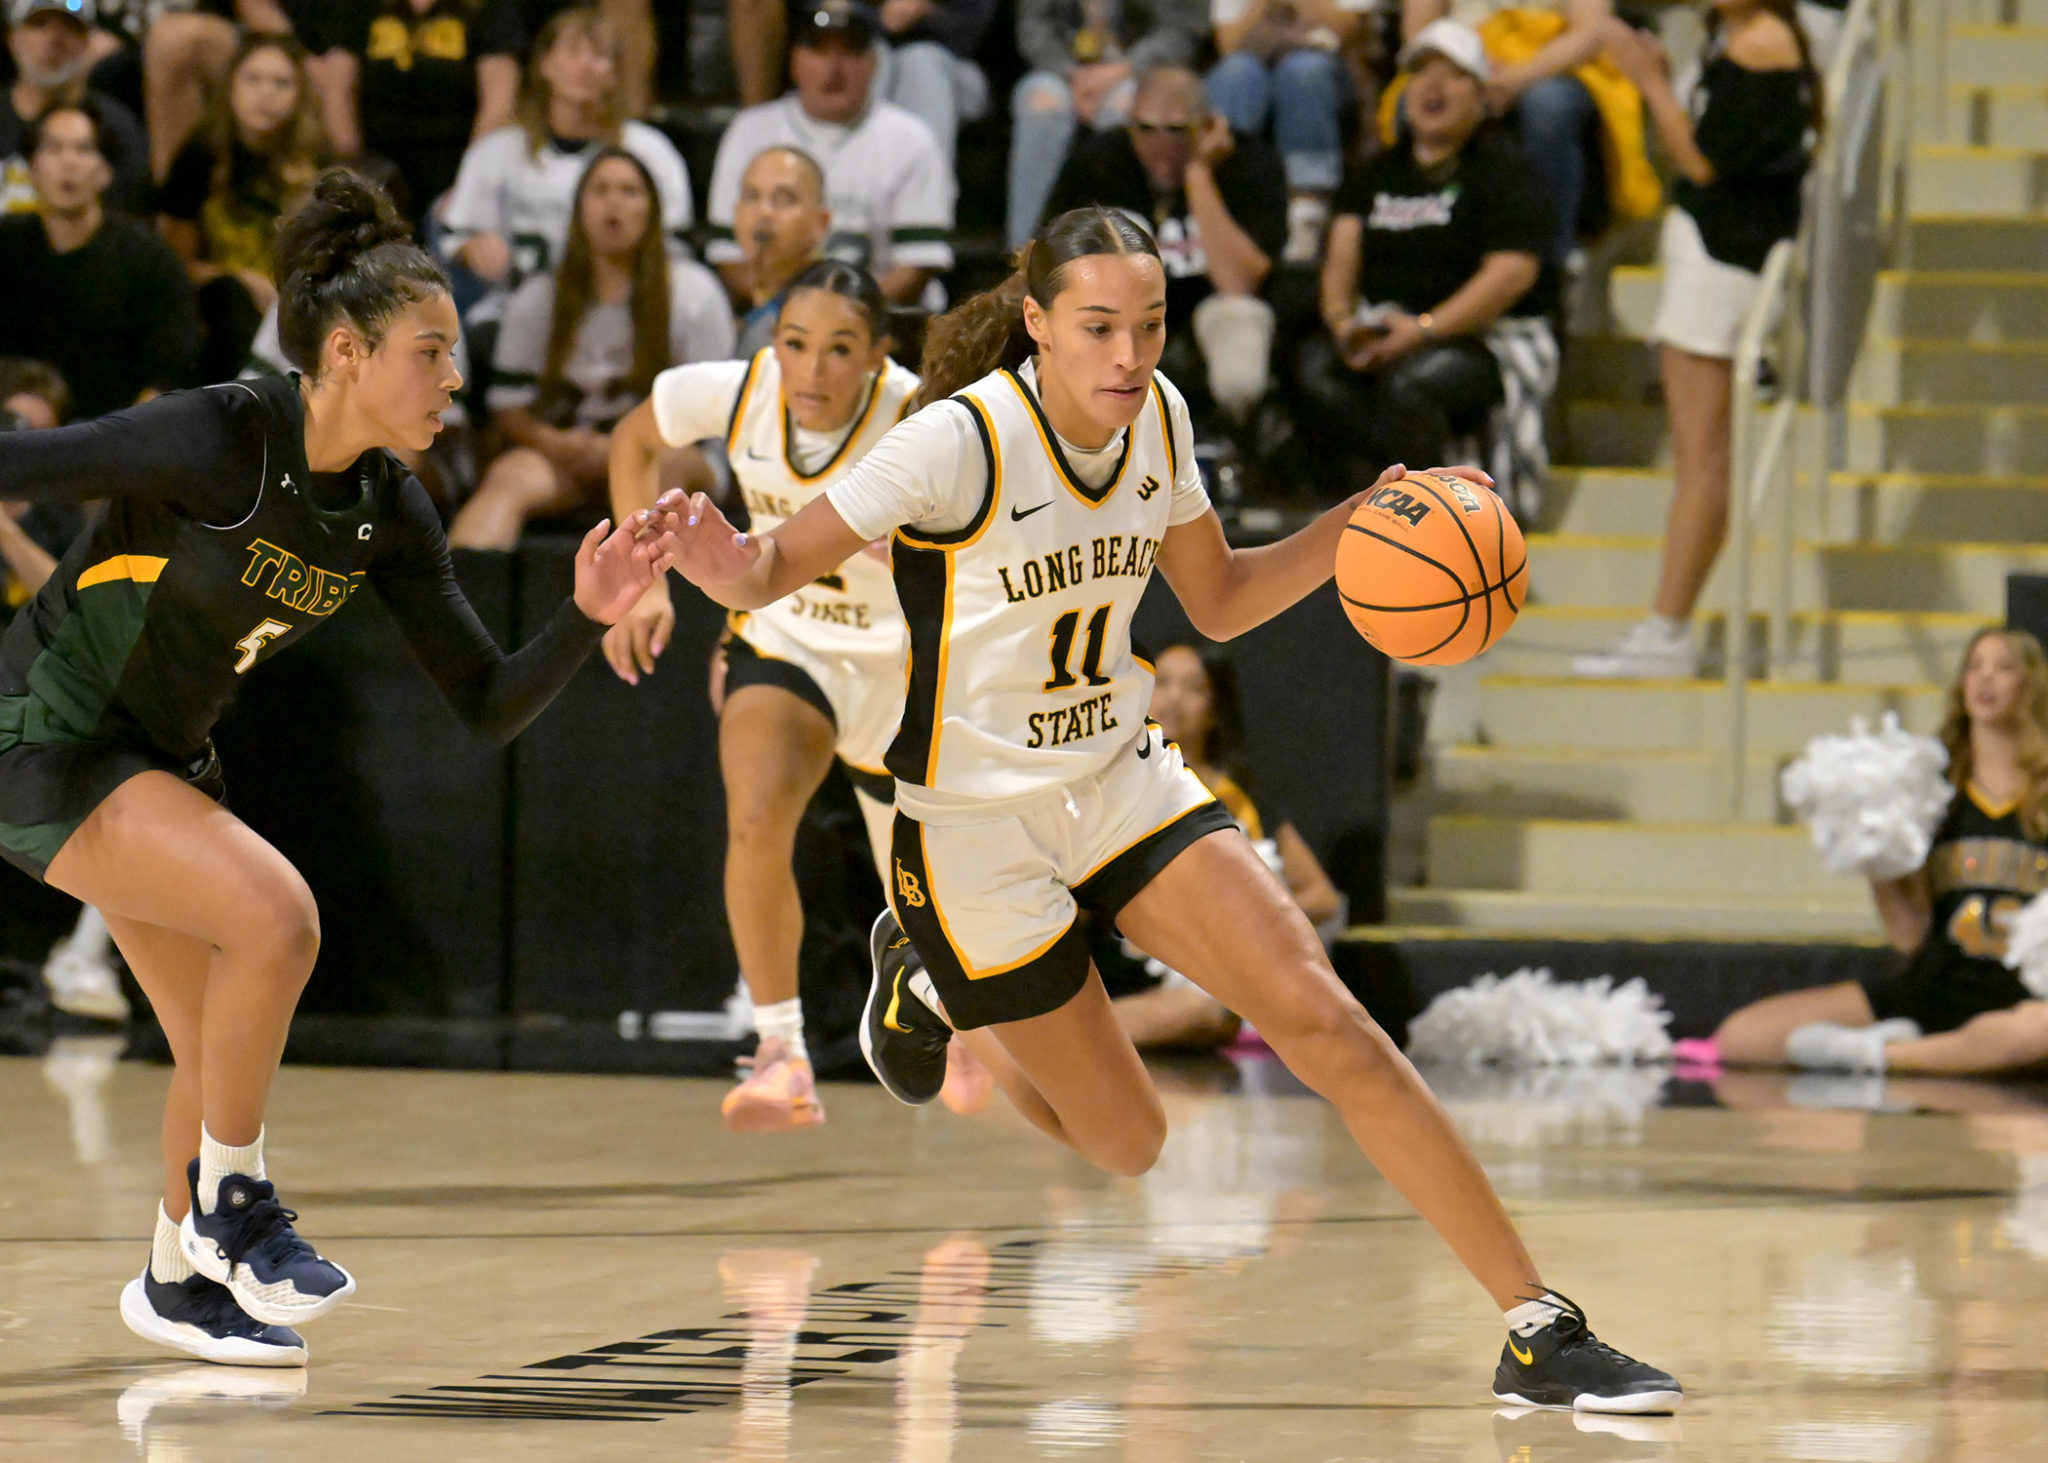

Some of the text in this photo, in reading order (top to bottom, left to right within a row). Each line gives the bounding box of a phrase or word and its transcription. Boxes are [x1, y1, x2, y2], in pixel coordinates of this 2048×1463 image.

[998, 544, 1084, 603] LONG
[234, 617, 294, 675] 5
[1042, 601, 1114, 694] 11
[1027, 692, 1118, 748] STATE
